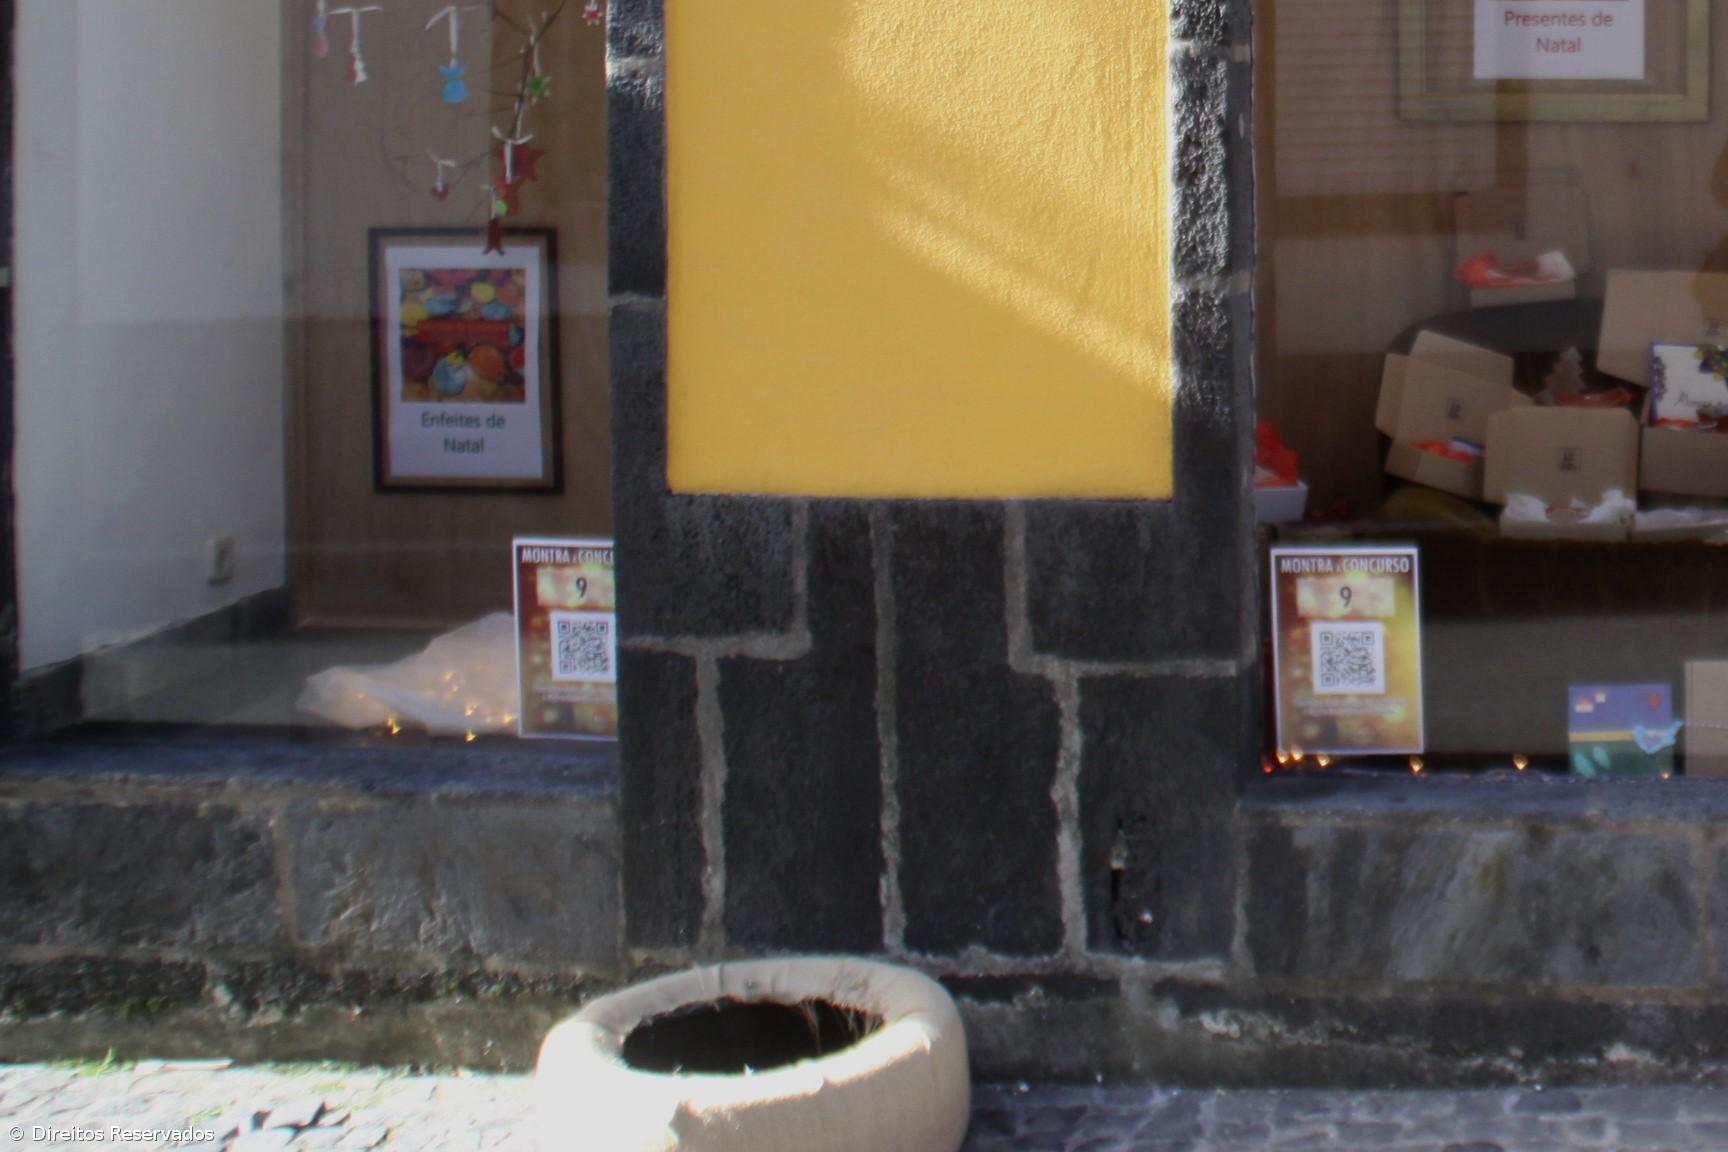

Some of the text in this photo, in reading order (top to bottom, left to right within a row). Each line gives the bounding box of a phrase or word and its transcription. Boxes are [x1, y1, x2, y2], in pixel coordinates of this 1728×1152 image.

[1504, 11, 1614, 27] Presentes de
[1537, 38, 1582, 54] Natal
[421, 412, 506, 429] Enfeites de
[444, 438, 485, 454] Natal
[521, 547, 570, 564] MONTRA
[1280, 558, 1333, 574] MONTRA
[1342, 558, 1410, 574] CONCURSO
[575, 577, 588, 598] 9
[1340, 586, 1352, 608] 9
